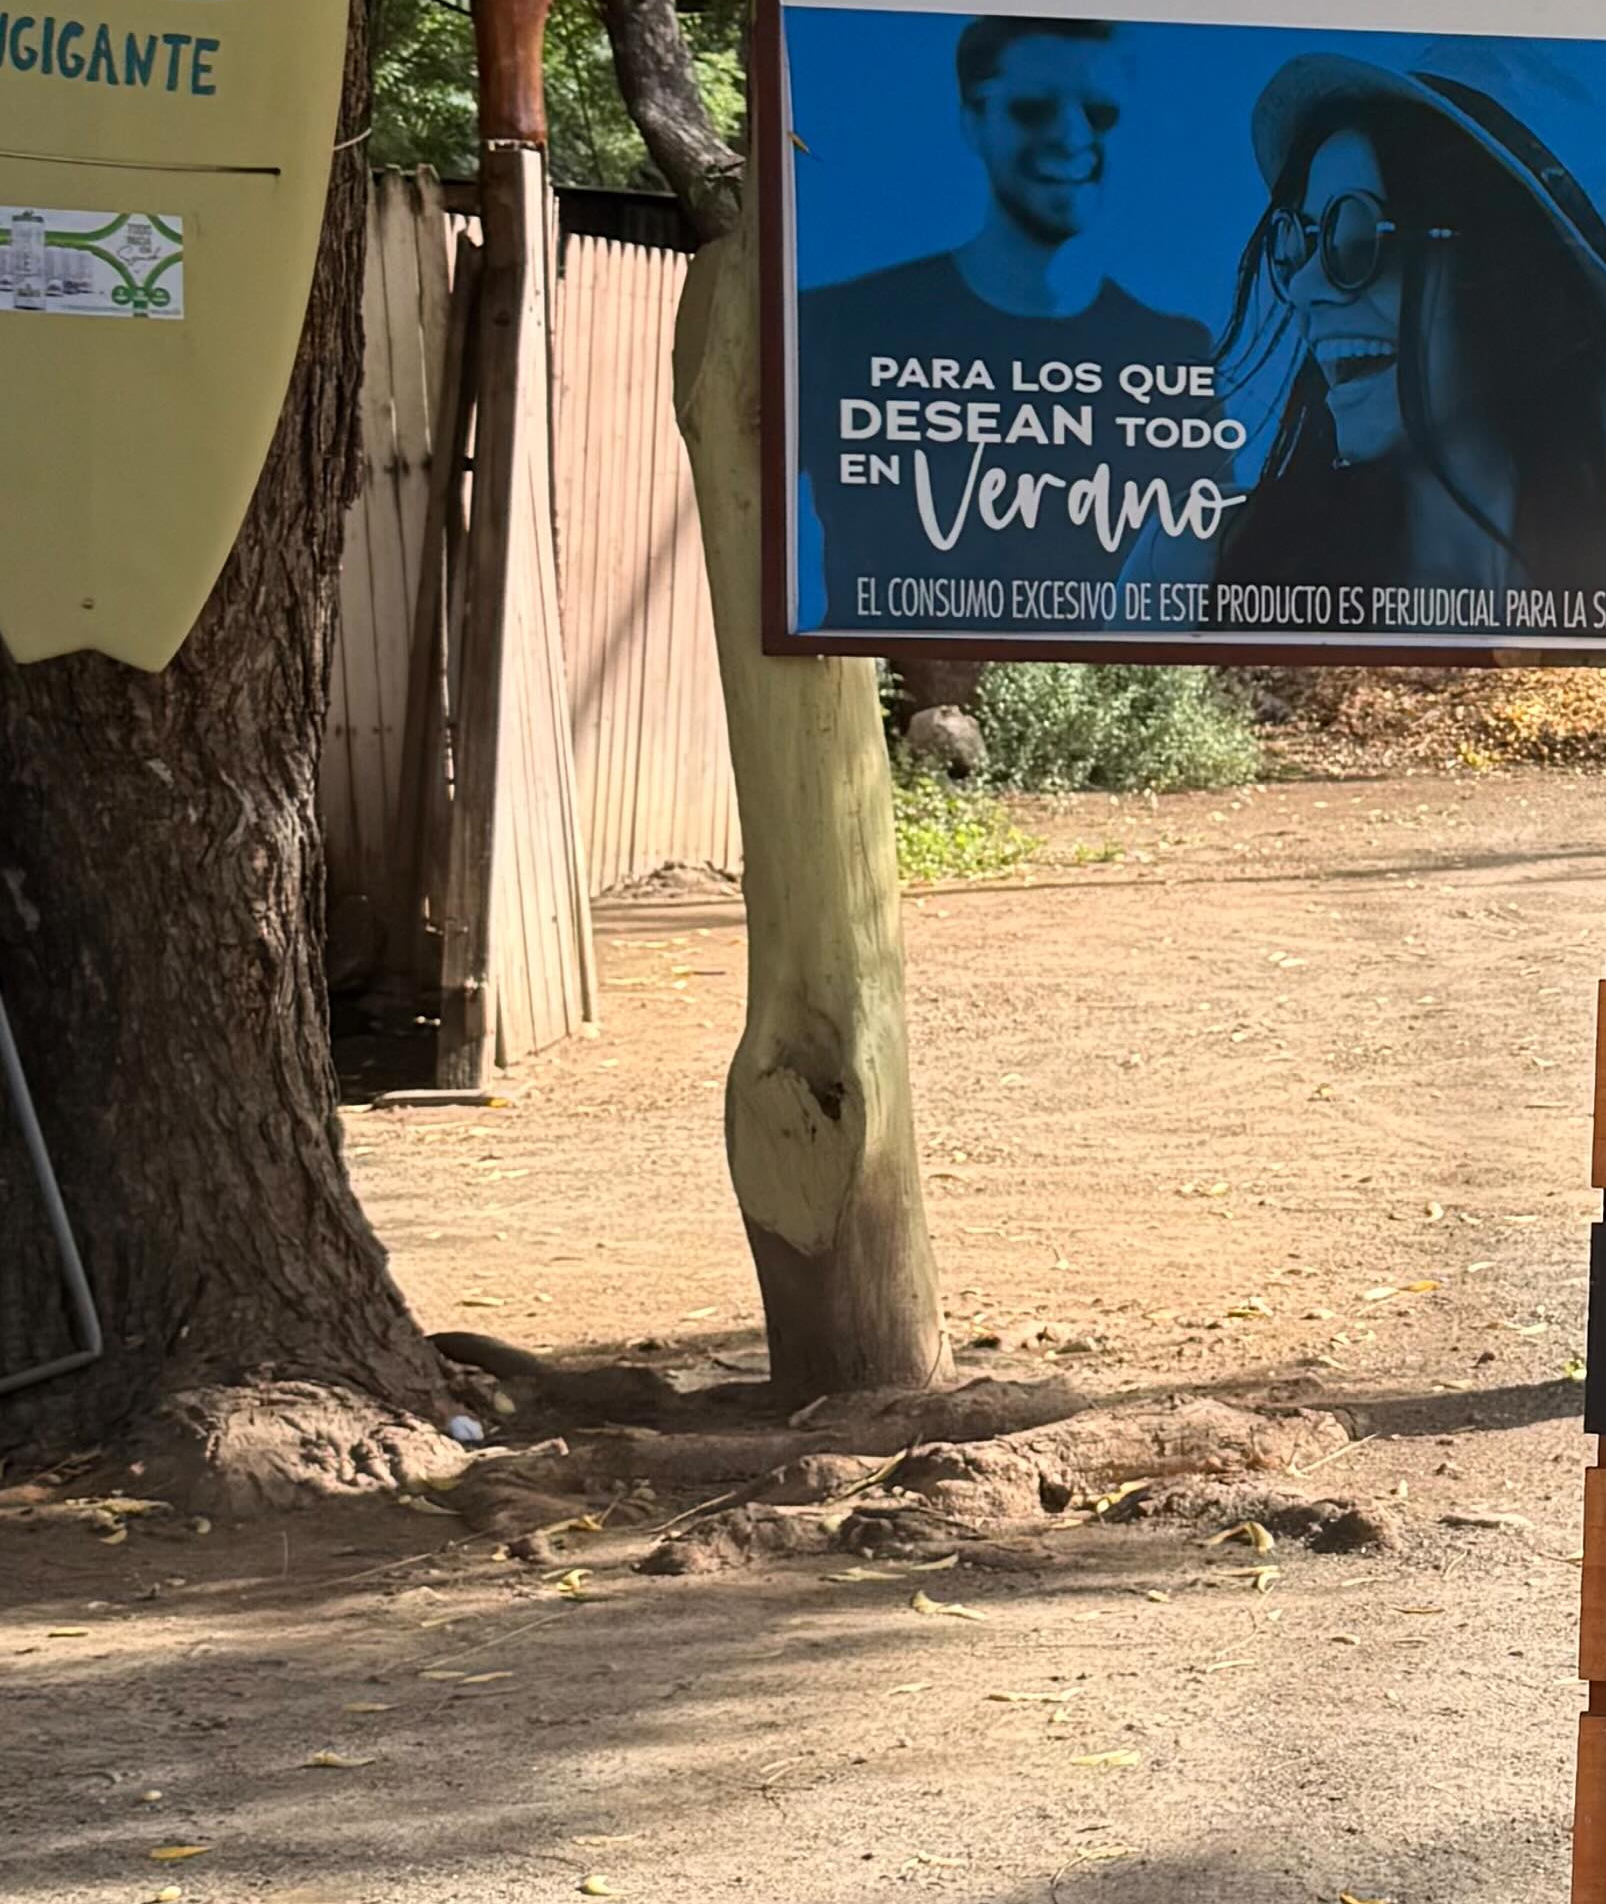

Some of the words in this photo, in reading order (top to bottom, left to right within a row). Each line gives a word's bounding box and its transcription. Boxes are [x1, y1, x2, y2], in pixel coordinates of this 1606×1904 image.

[0, 11, 221, 96] GIGANTE
[871, 356, 996, 390] PARA
[1012, 360, 1102, 395] LOS
[1119, 364, 1215, 404] QUE
[839, 398, 1093, 446] DESEAN
[1115, 416, 1247, 450] TODO
[840, 453, 901, 485] EN
[914, 441, 1247, 553] Verano
[857, 577, 882, 616] EL
[887, 577, 1003, 619] CONSUMO
[1011, 579, 1117, 621] EXCESIVO
[1125, 582, 1152, 622] DE
[1159, 582, 1209, 623] ESTE
[1217, 583, 1331, 625] PRODUCTO
[1339, 585, 1365, 625] ES
[1372, 586, 1499, 628] PERJUDICIAL
[1505, 588, 1557, 629] PARA
[1563, 590, 1588, 629] LA
